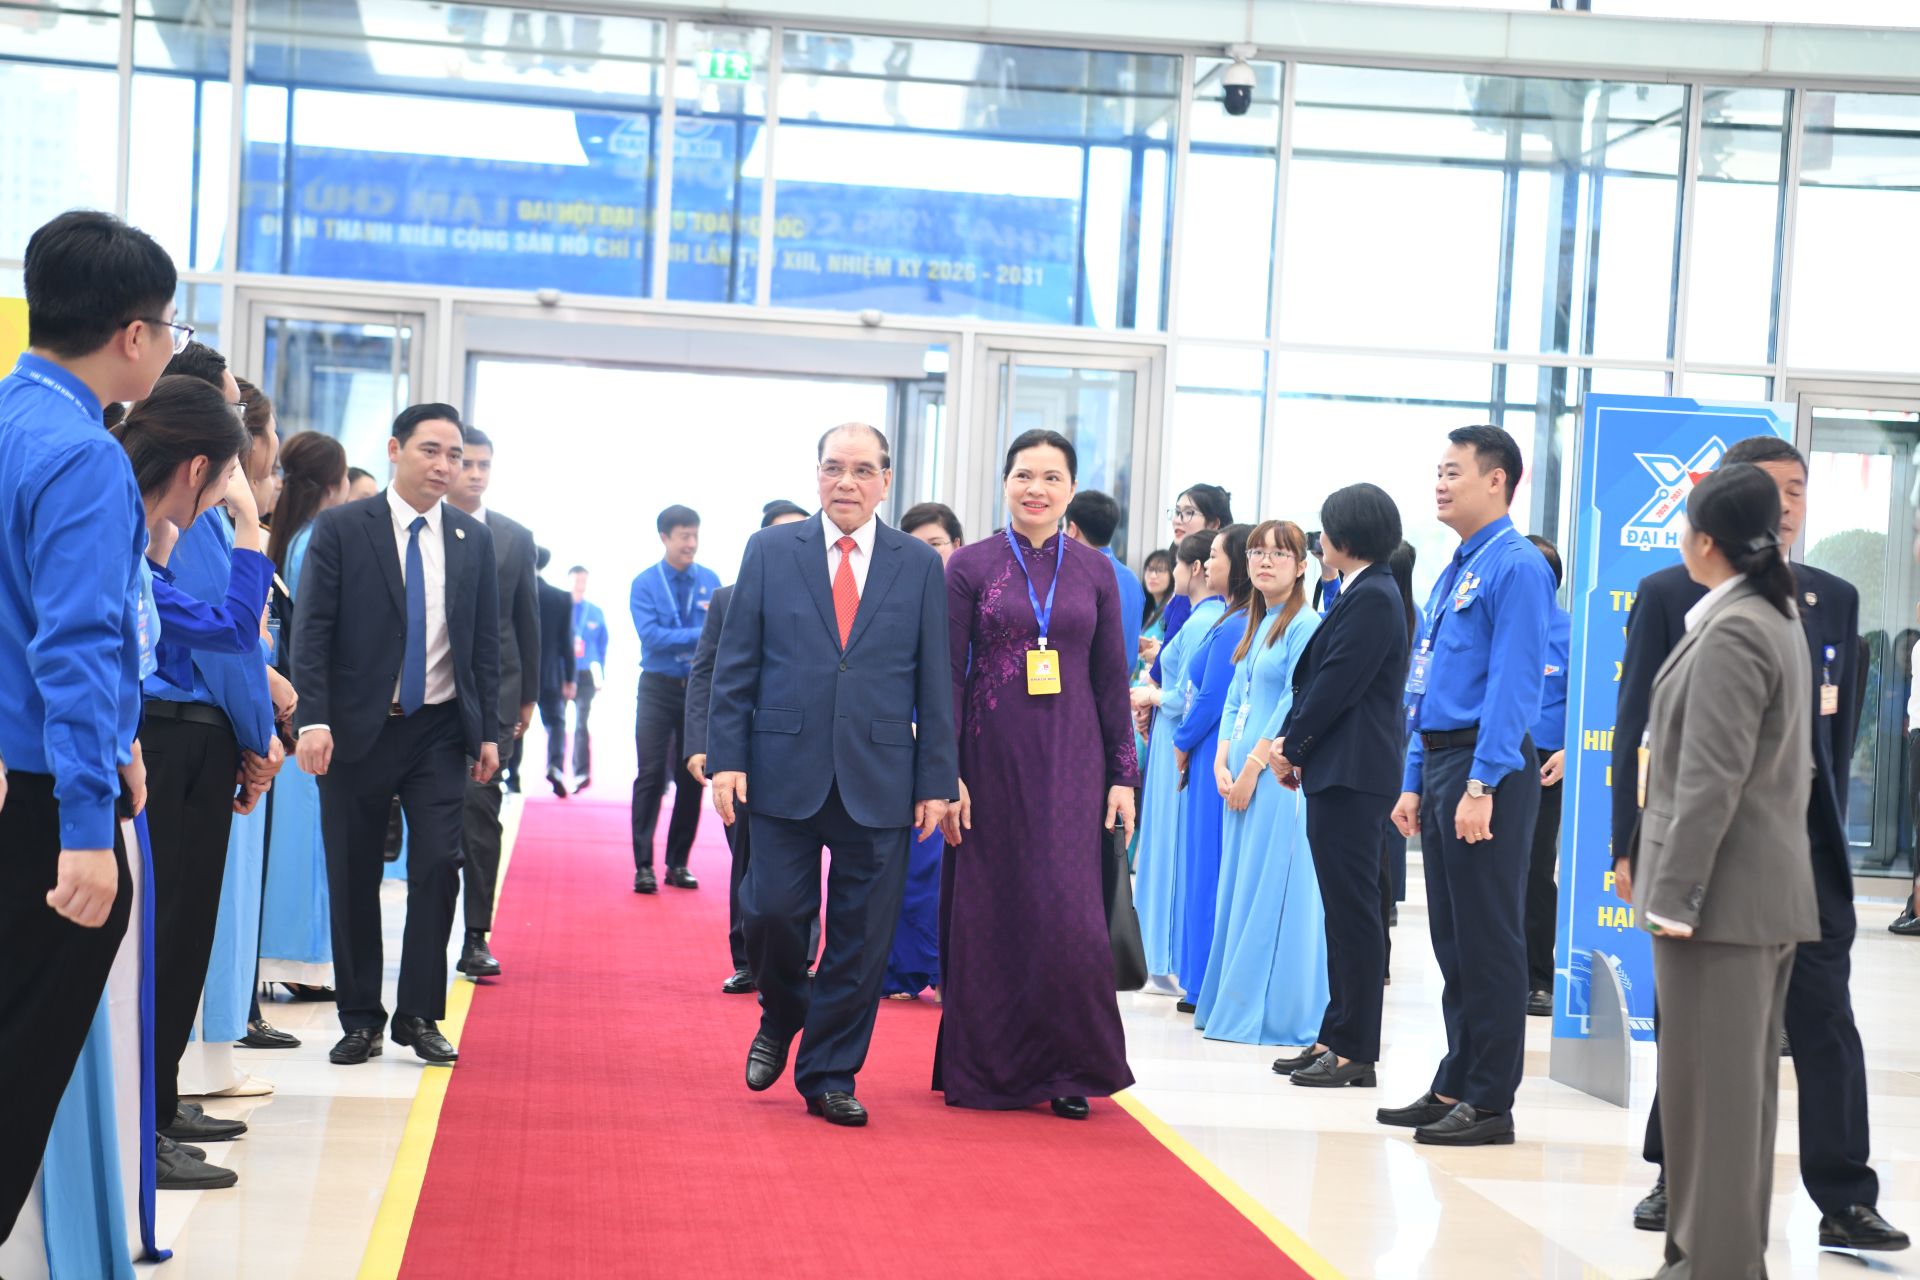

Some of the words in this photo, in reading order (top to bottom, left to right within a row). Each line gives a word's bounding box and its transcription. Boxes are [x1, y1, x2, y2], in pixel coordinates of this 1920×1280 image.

[557, 200, 595, 227] HỘI
[692, 207, 741, 234] TOÀ
[749, 213, 805, 239] QỐC
[261, 213, 318, 239] ĐÀN
[324, 217, 393, 243] THANH
[399, 221, 447, 247] NIÊN
[452, 224, 509, 252] CỘNG
[514, 227, 554, 254] SẢN
[559, 229, 589, 257] HỒ
[593, 233, 629, 260] CHÍ
[783, 250, 821, 275] XIII,
[828, 252, 892, 279] NHIỆM
[927, 260, 976, 282] 2026
[996, 263, 1044, 287] 2031
[1626, 530, 1657, 548] ĐẠI
